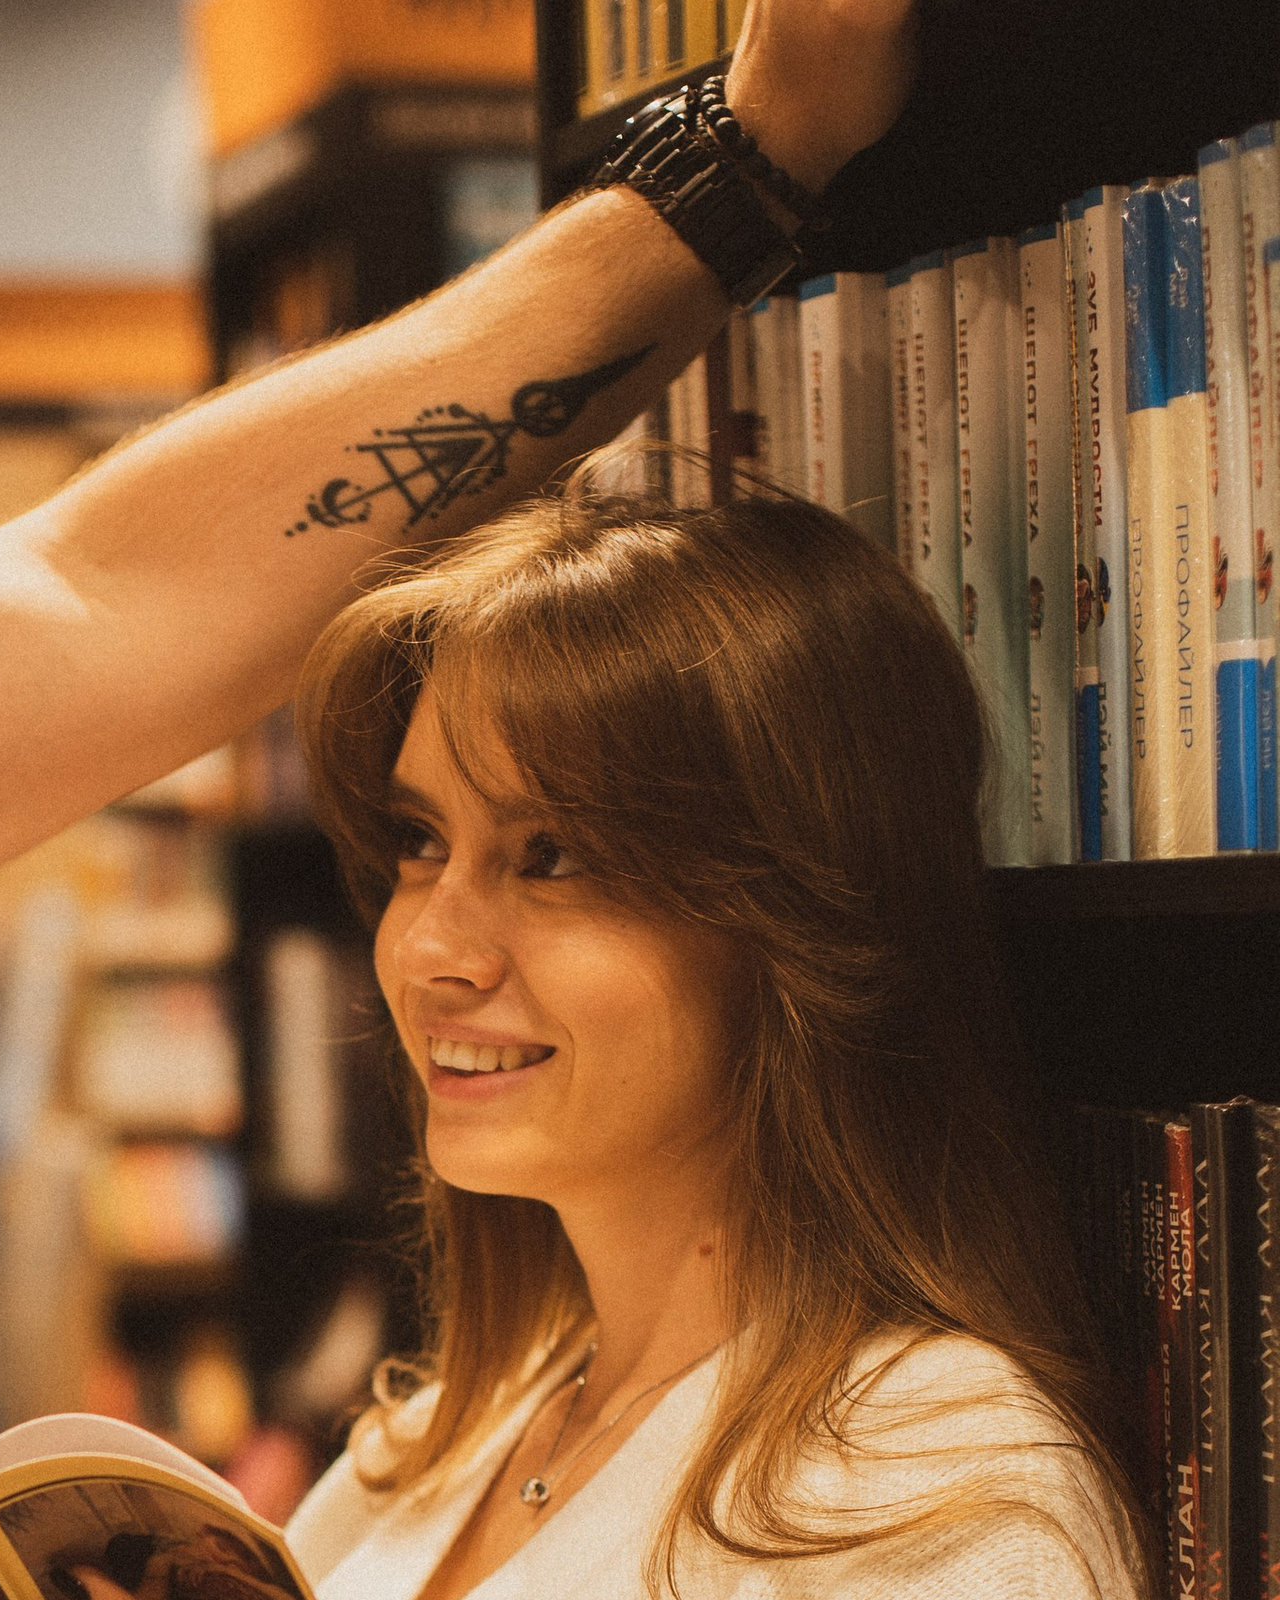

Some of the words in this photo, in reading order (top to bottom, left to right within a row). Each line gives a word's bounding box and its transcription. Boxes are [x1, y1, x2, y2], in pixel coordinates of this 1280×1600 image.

[1086, 270, 1099, 333] ЗУБ
[958, 318, 970, 434] ШЕПОТ
[1025, 305, 1038, 425] ШЕПОТ
[961, 448, 974, 548] ГРЕХА
[1027, 438, 1040, 543] ГРЕХА
[1131, 518, 1147, 760] ПРОФАЙЛЕР
[1175, 504, 1195, 750] ПРОФАЙЛЕР
[1140, 1180, 1152, 1296] КАРМЕН
[1154, 1183, 1166, 1301] КАРМЕН
[1169, 1192, 1182, 1310] КАРМЕН
[1179, 1206, 1193, 1297] МОЛА
[1195, 1158, 1211, 1262] АДА
[1198, 1287, 1213, 1475] ПЛАМЯ
